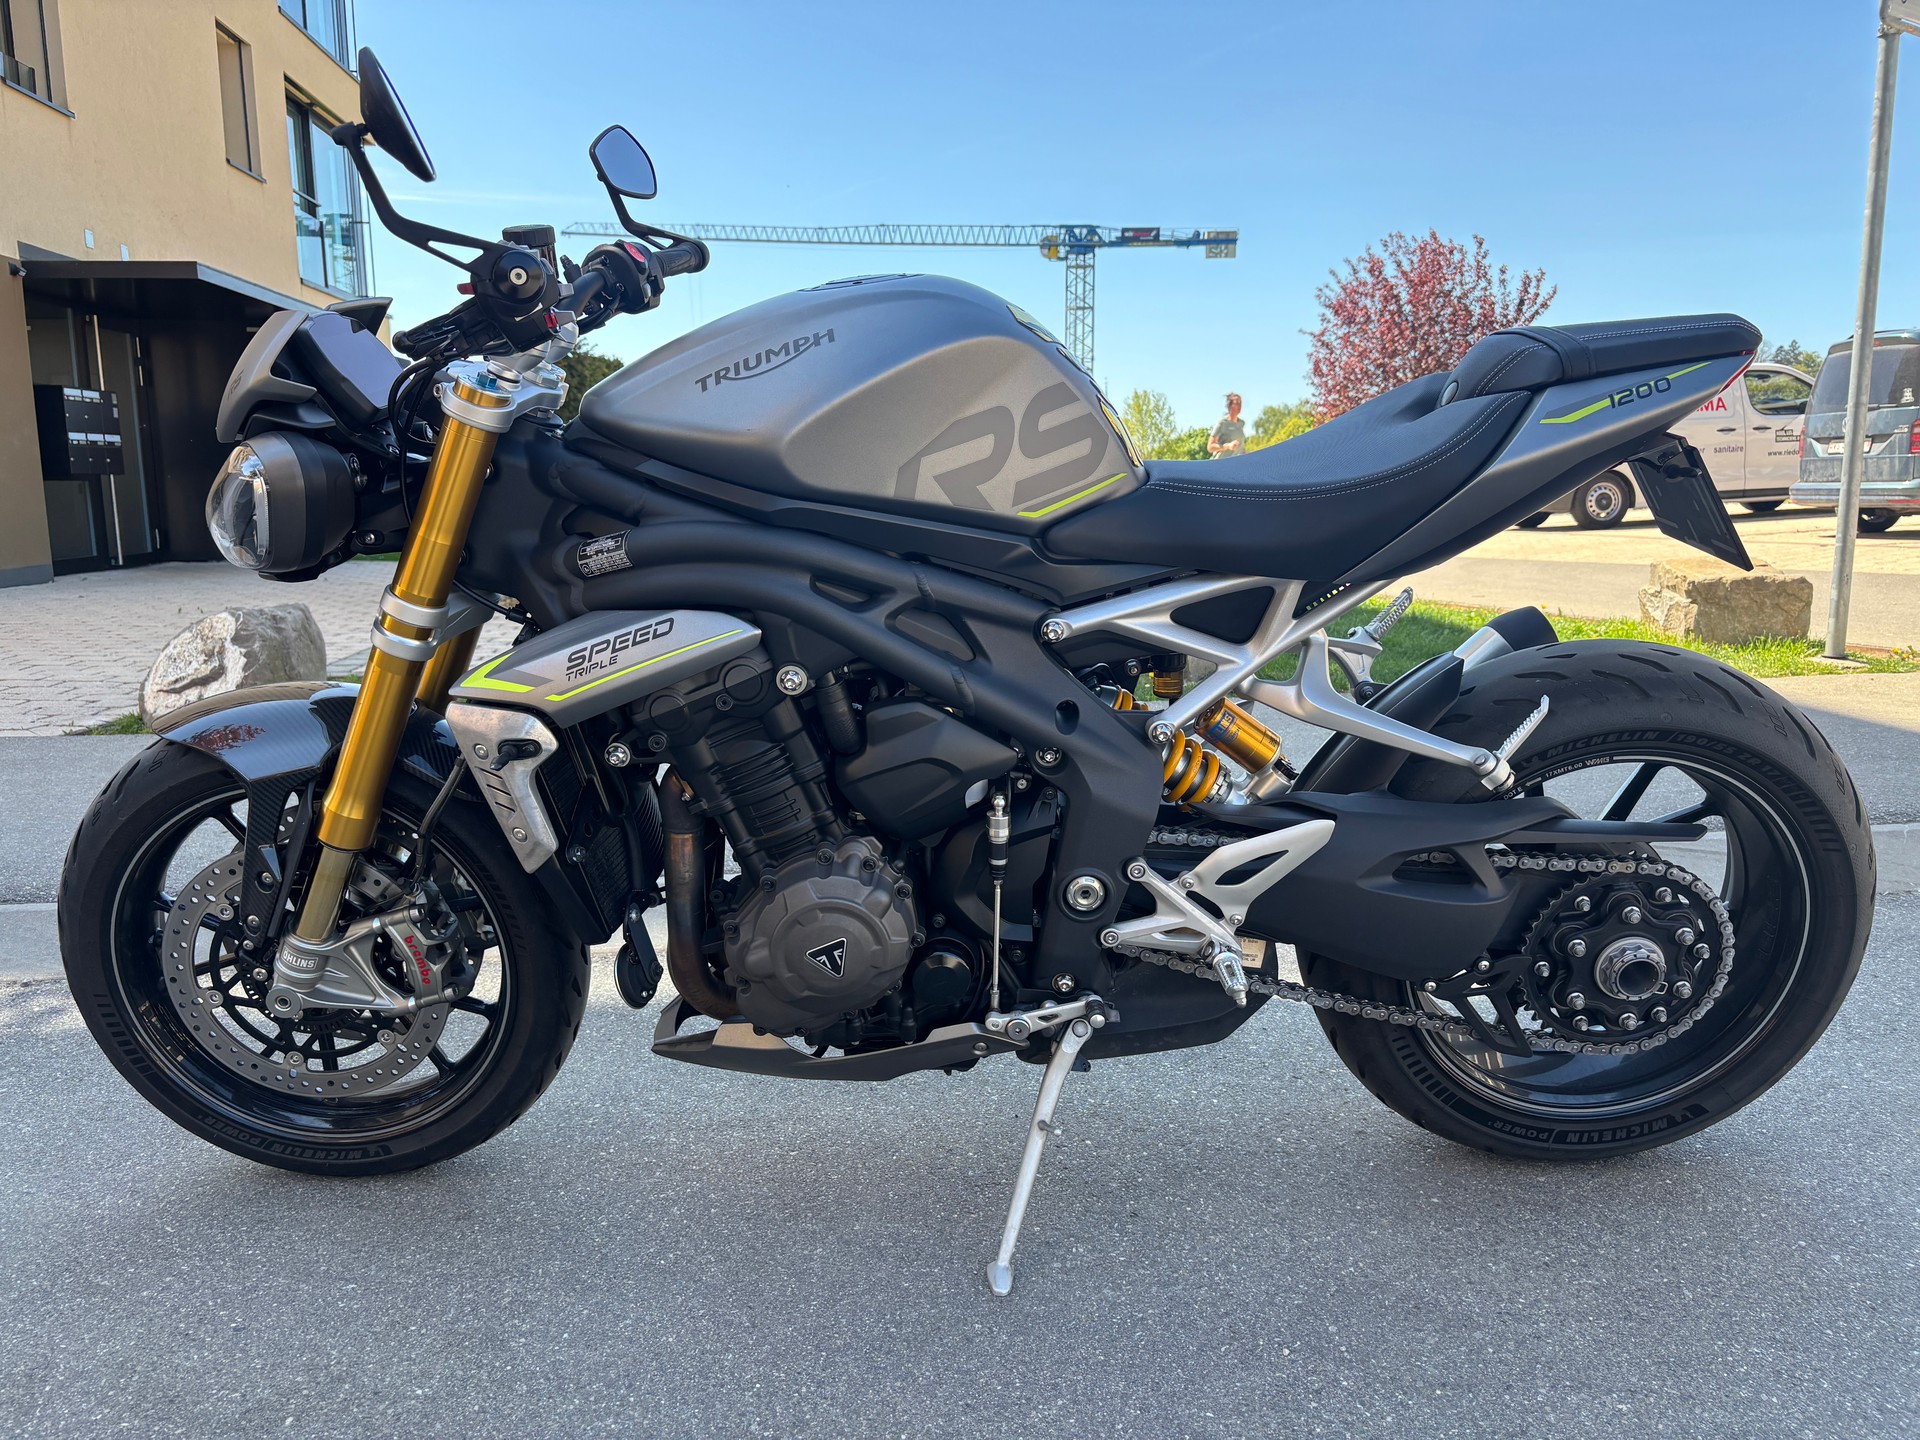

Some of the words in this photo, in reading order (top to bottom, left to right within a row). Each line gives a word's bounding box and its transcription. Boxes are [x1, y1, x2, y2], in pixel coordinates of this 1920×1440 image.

[695, 328, 835, 393] TRIUMPH
[1608, 377, 1671, 409] 1200
[1697, 397, 1728, 412] MA
[894, 382, 1109, 511] RS
[1713, 444, 1744, 454] sanitaire
[566, 617, 675, 671] SPEED
[566, 654, 618, 681] TRIPLE
[1547, 731, 1660, 758] MICHELIN
[1676, 733, 1736, 754] 190/55
[1737, 752, 1762, 766] ZR
[404, 935, 431, 985] brembo
[1566, 1119, 1668, 1143] MICHELIN
[271, 1143, 362, 1160] MICHELIN
